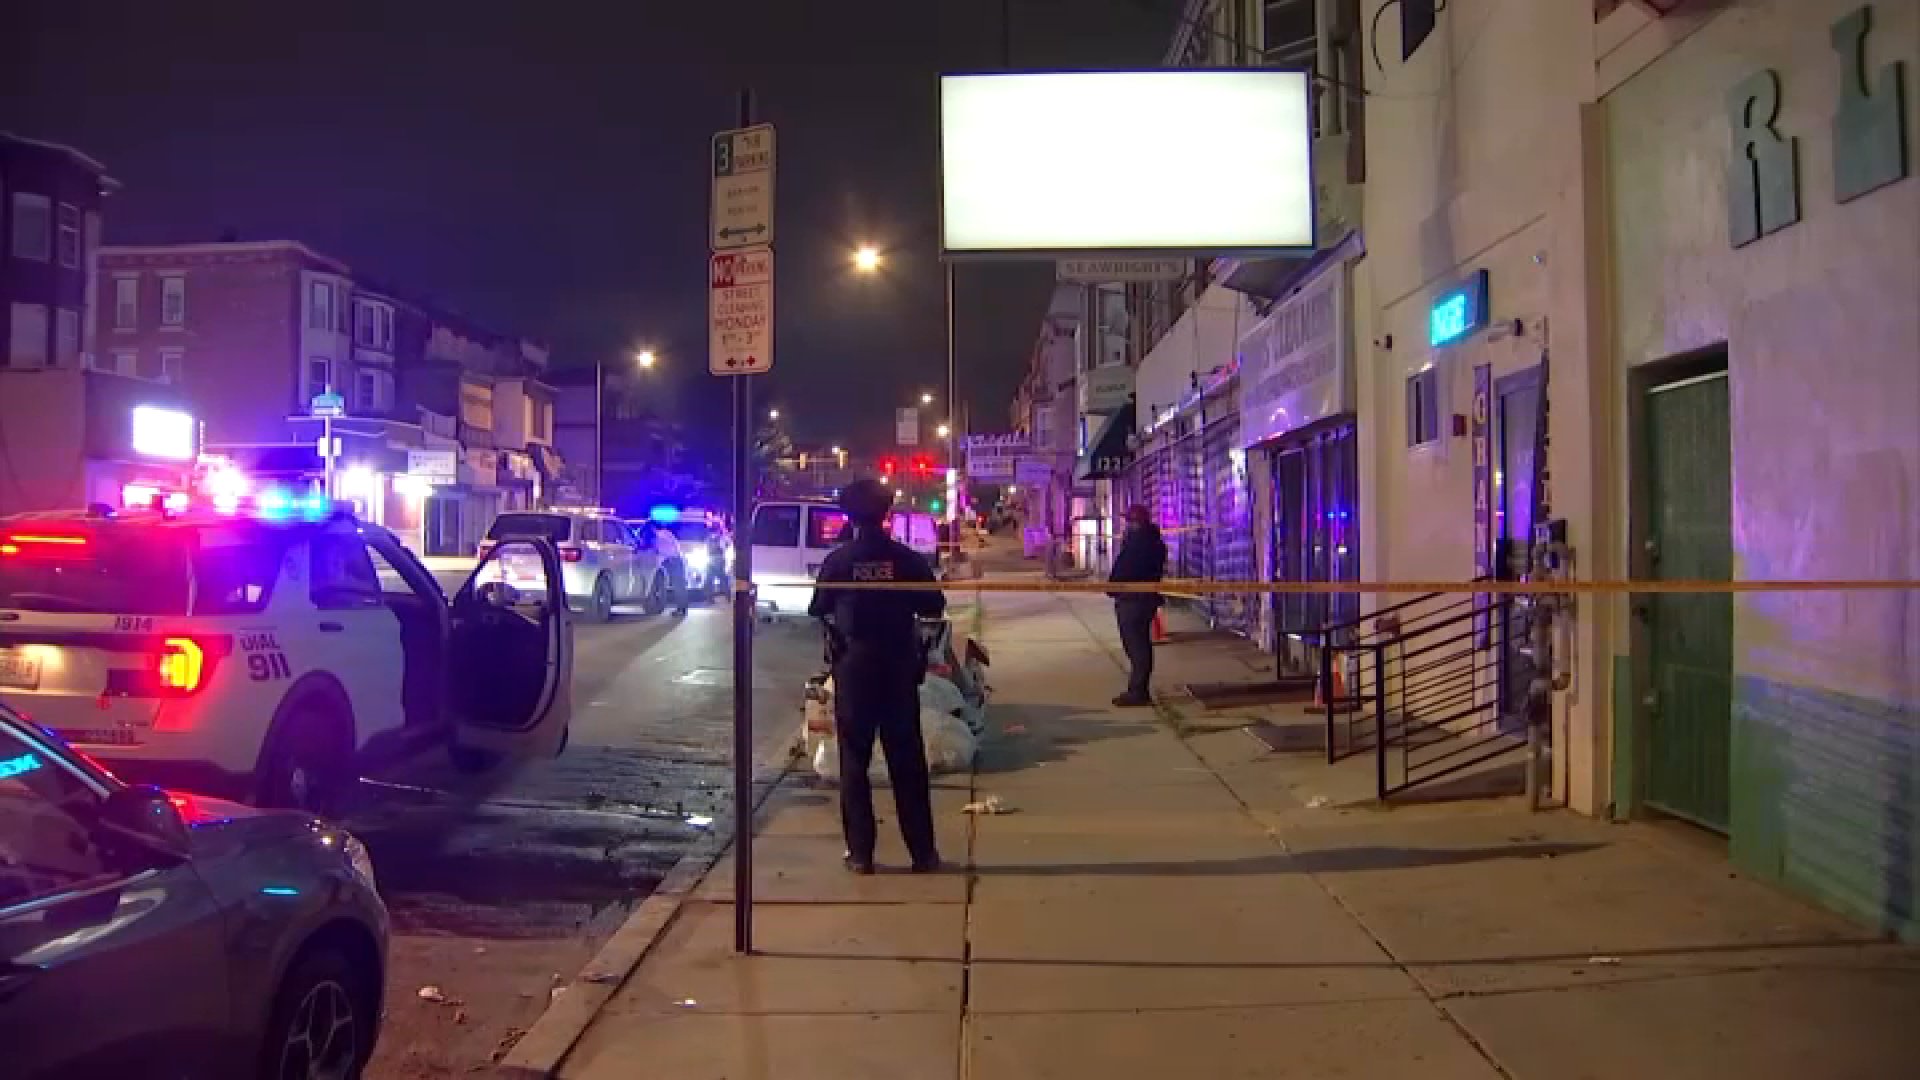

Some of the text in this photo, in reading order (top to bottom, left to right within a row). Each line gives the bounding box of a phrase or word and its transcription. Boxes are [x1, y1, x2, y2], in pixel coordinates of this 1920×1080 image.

[722, 288, 760, 301] STREET
[717, 301, 765, 315] CLEANING
[714, 315, 766, 331] MONDAY
[853, 567, 894, 581] POLICE
[113, 615, 153, 632] 1914
[241, 633, 281, 652] DIAL
[248, 652, 291, 681] 911
